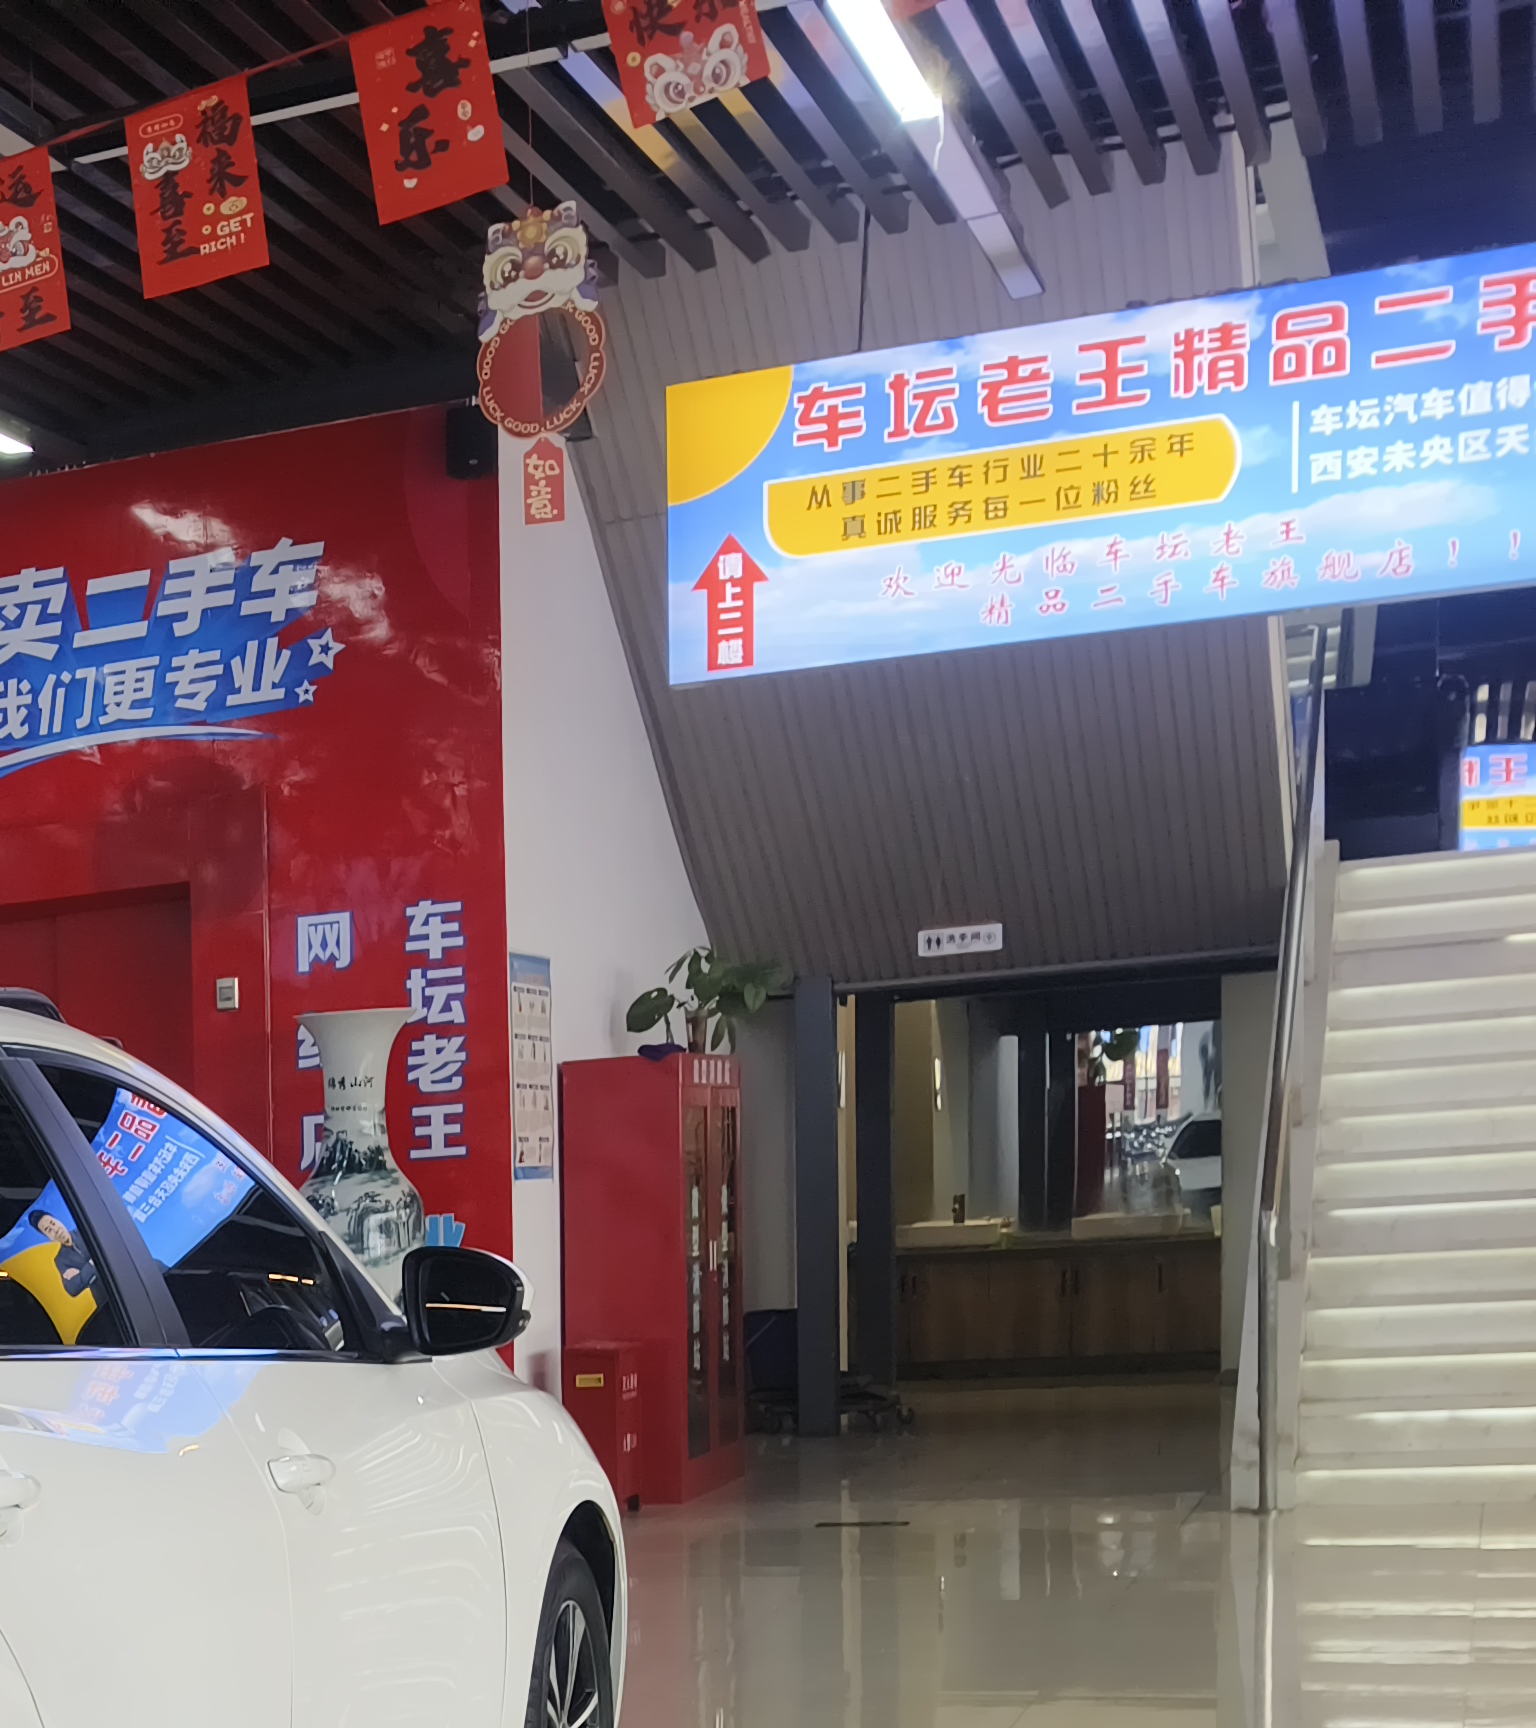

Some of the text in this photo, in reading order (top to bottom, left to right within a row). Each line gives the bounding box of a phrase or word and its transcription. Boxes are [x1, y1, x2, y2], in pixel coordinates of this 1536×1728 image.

[217, 213, 254, 235] GET
[2, 272, 21, 286] LIN
[25, 261, 51, 280] MEN
[575, 309, 599, 346] GOOD
[481, 336, 500, 380] GOOD
[579, 352, 601, 394] LUCK
[793, 266, 1536, 452] 车坛老王精品二手
[482, 385, 505, 422] LUCK
[545, 398, 581, 430] LUCK
[504, 416, 539, 434] GOOD
[806, 431, 1197, 511] 从事二手车行业二十余年
[841, 474, 1159, 541] 真诚服务每一位粉丝
[880, 518, 1305, 599] 欢迎光临车坛老王
[404, 899, 469, 1160] 车坛老王
